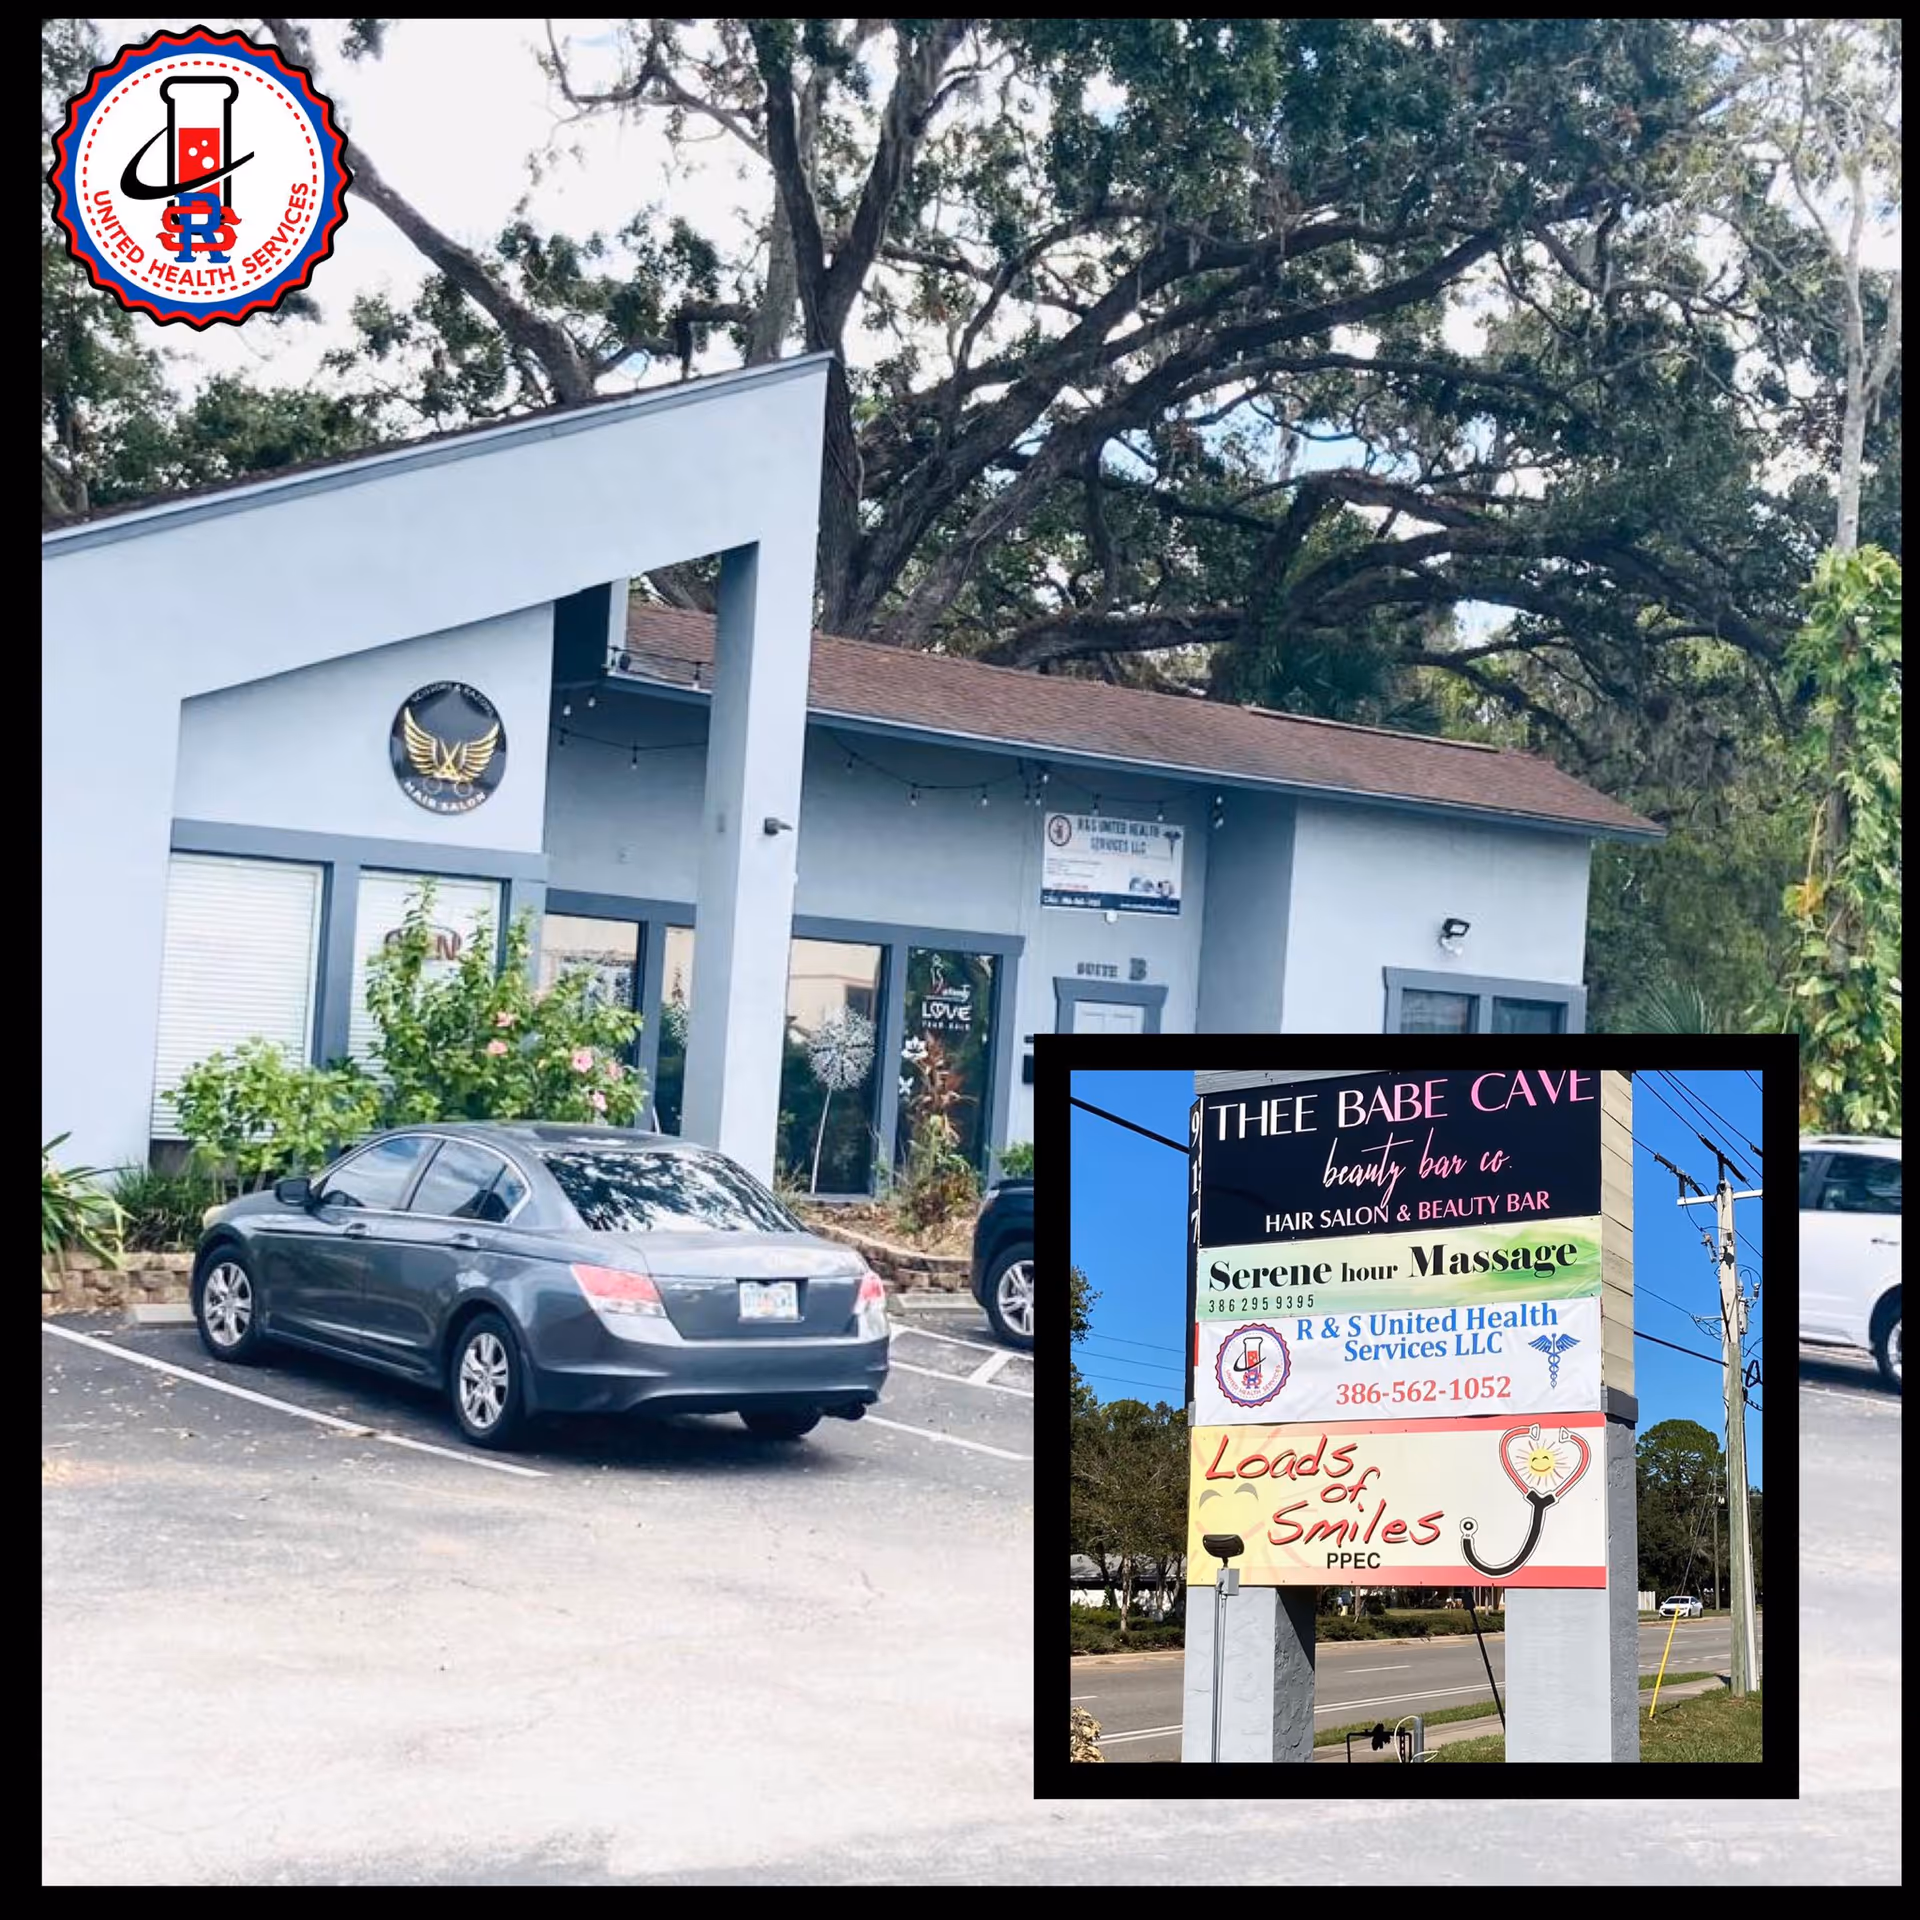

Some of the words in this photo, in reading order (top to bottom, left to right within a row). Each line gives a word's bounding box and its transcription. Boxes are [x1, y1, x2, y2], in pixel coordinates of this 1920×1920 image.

[404, 781, 437, 809] HAIR
[441, 791, 486, 811] SALON
[1077, 962, 1119, 978] SUITE
[1128, 958, 1147, 981] B
[922, 1001, 973, 1021] LOVE
[1209, 1094, 1318, 1141] THEE
[1338, 1078, 1448, 1128] BABE
[1470, 1070, 1595, 1112] CAVE
[1323, 1132, 1414, 1208] beauty
[1418, 1127, 1467, 1179] bar
[1480, 1150, 1513, 1173] co.
[1266, 1212, 1314, 1233] HAIR
[1320, 1205, 1389, 1229] SALON
[1396, 1204, 1411, 1222] &
[1418, 1194, 1500, 1220] BEAUTY
[1506, 1190, 1550, 1213] BAR
[1209, 1260, 1332, 1292] Serene
[1341, 1262, 1398, 1283] hour
[1408, 1243, 1578, 1279] Massage
[1208, 1298, 1235, 1313] 386
[1242, 1297, 1269, 1312] 295
[1276, 1294, 1314, 1310] 9395
[1296, 1318, 1313, 1341] R
[1321, 1316, 1341, 1339] &
[1348, 1315, 1362, 1337] S
[1370, 1308, 1457, 1337] United
[1466, 1302, 1558, 1330] Health
[1344, 1337, 1447, 1362] Services
[1455, 1331, 1503, 1357] LLC
[1336, 1375, 1512, 1405] 386-562-1052
[1205, 1433, 1358, 1480] Loads
[1320, 1466, 1381, 1504] of
[1268, 1498, 1445, 1548] Smiles
[1326, 1552, 1382, 1570] PPEC
